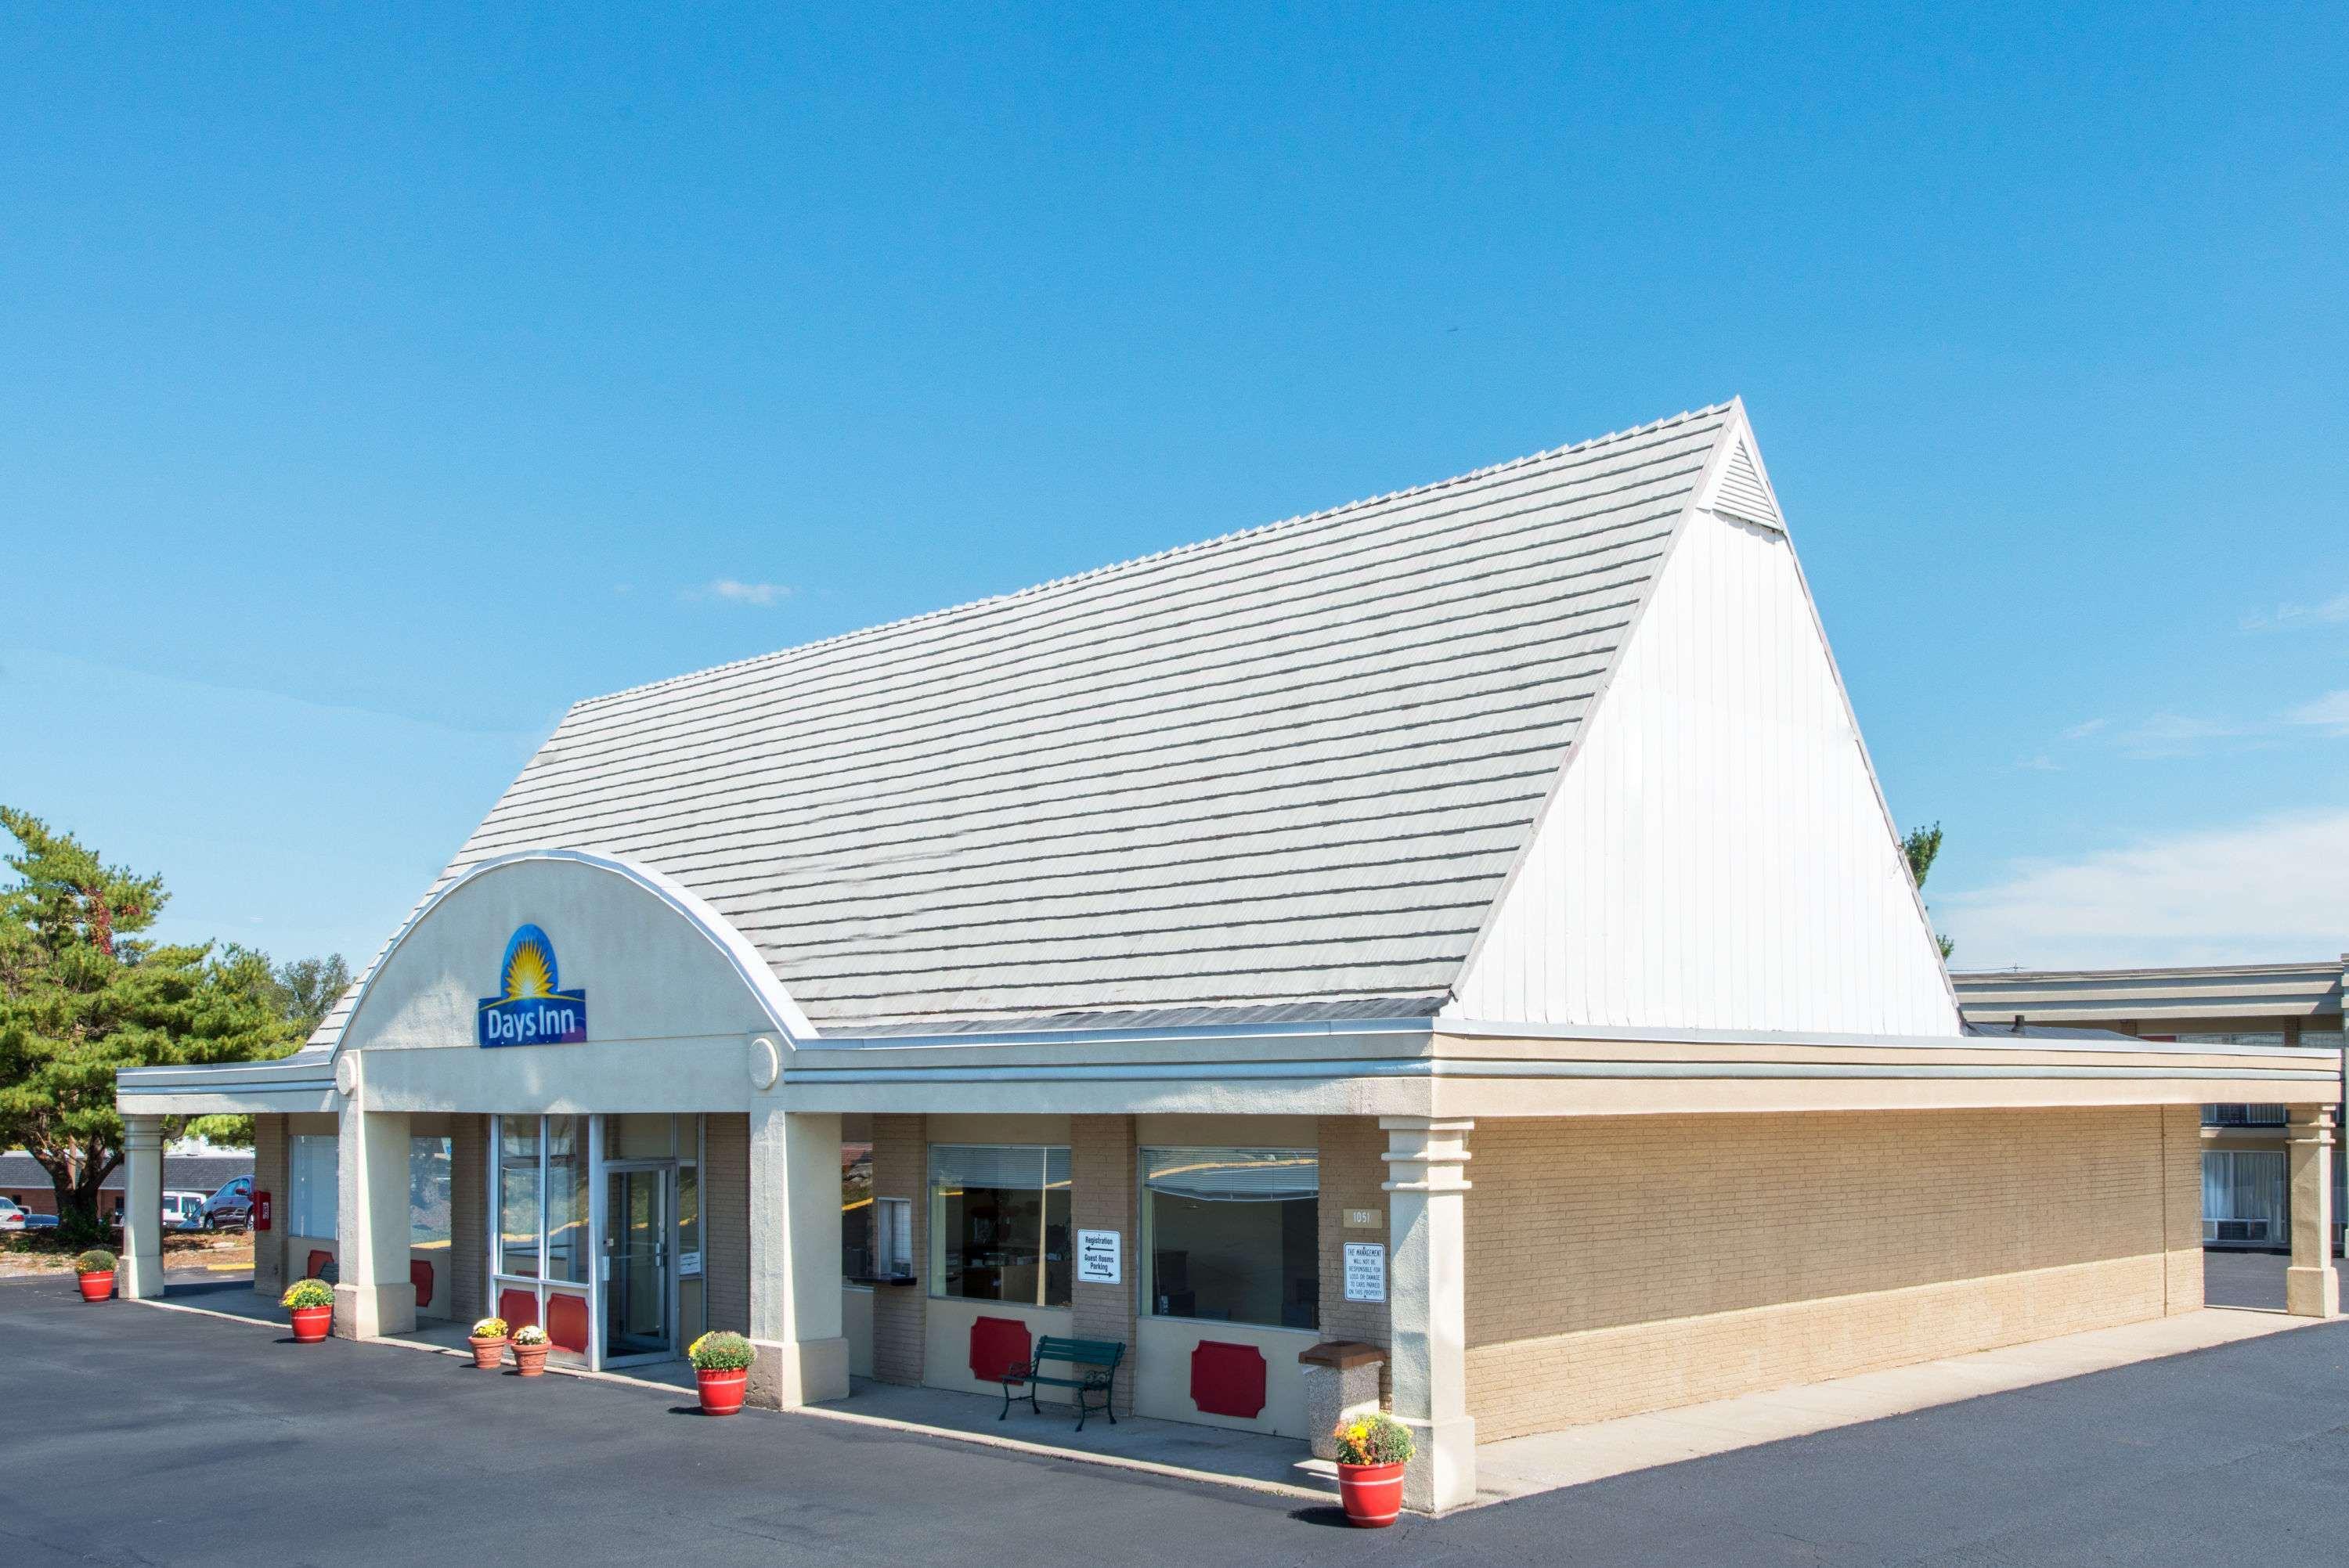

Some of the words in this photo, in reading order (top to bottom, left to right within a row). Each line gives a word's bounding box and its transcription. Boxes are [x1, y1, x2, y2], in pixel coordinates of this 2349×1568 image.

[488, 1009, 536, 1042] Days
[539, 1005, 576, 1036] Inn
[1085, 1236, 1113, 1245] Registration
[1084, 1253, 1097, 1262] Guest
[1099, 1254, 1113, 1263] Rooms
[1356, 1249, 1381, 1257] MANAGEMENT
[1090, 1262, 1108, 1272] Parking
